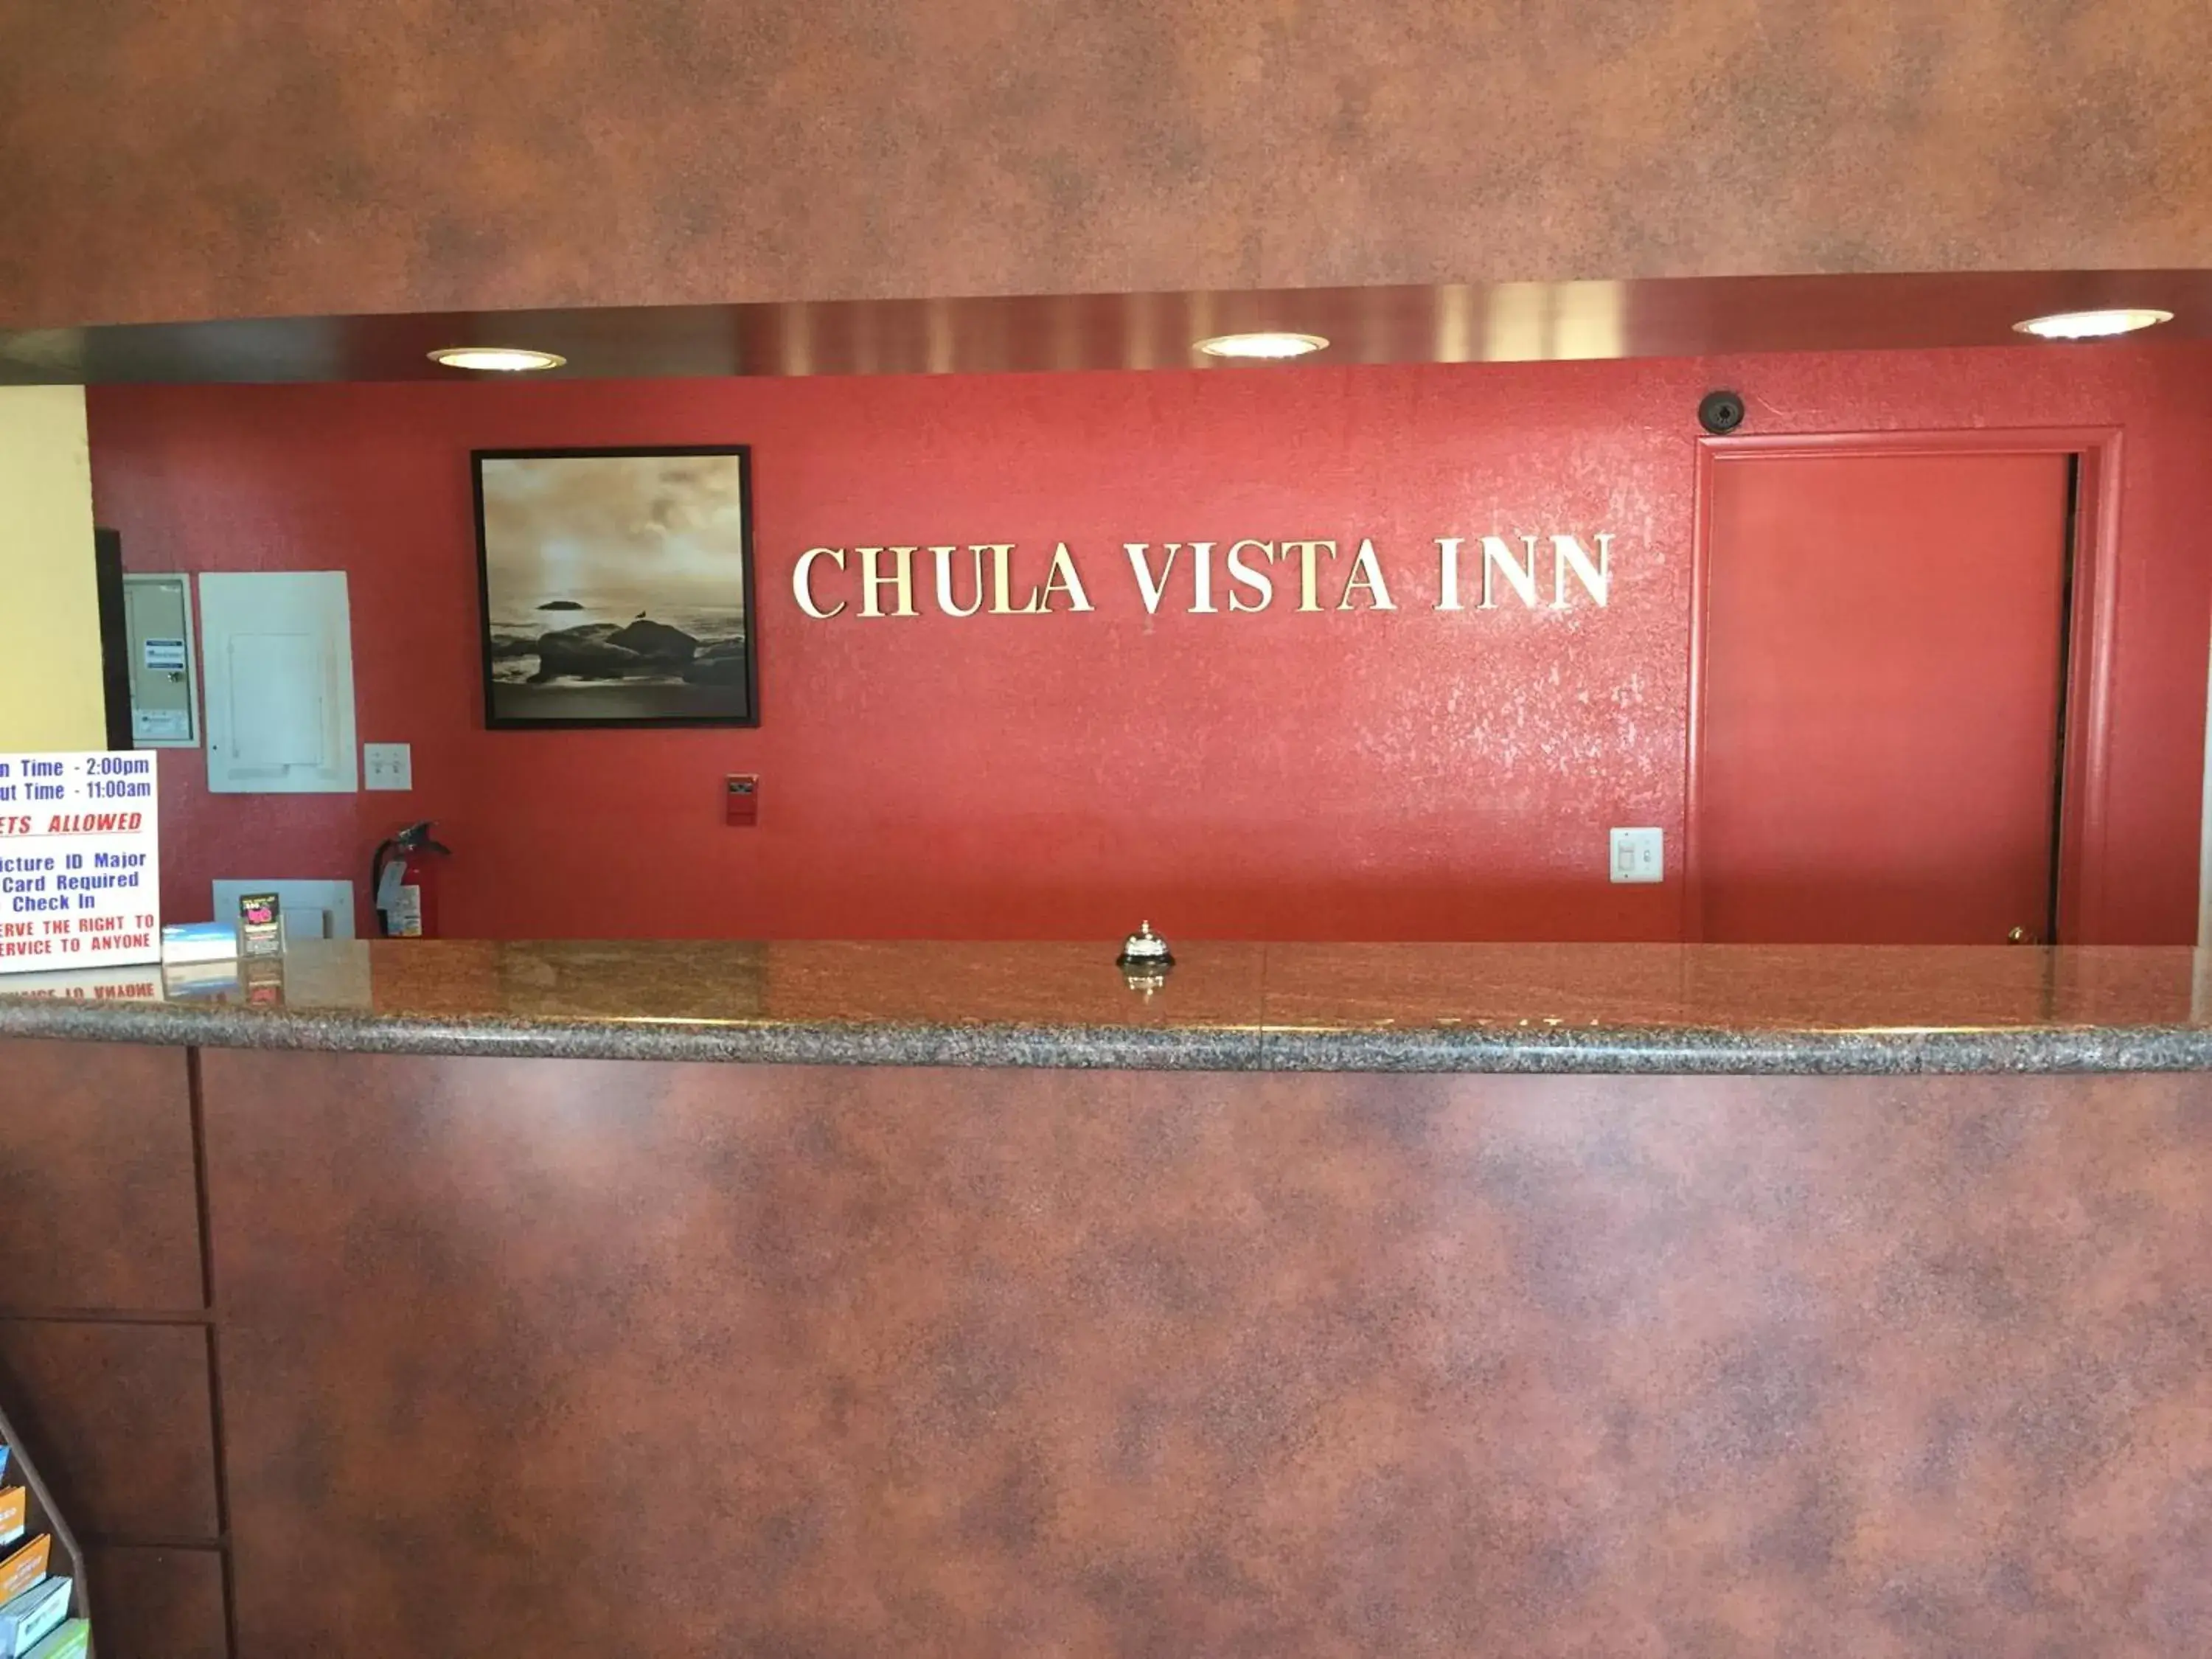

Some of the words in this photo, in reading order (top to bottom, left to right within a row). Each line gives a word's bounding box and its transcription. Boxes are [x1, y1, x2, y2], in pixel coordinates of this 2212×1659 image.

[793, 542, 1096, 619] CHULA
[1123, 538, 1397, 615] VISTA
[1433, 533, 1616, 611] INN
[21, 759, 64, 777] Time
[87, 757, 150, 776] 2:00pm
[24, 782, 65, 801] Time
[87, 780, 151, 799] 11:00am
[48, 813, 142, 833] ALLOWED
[66, 853, 83, 870] ID
[94, 852, 147, 869] Major
[3, 875, 45, 894] Card
[57, 871, 139, 891] Required
[13, 894, 70, 913] Check
[78, 893, 95, 910] In
[43, 919, 71, 936] THE
[79, 915, 125, 933] RIGHT
[135, 914, 155, 930] TO
[60, 937, 80, 953] TO
[91, 933, 151, 952] ANYONE
